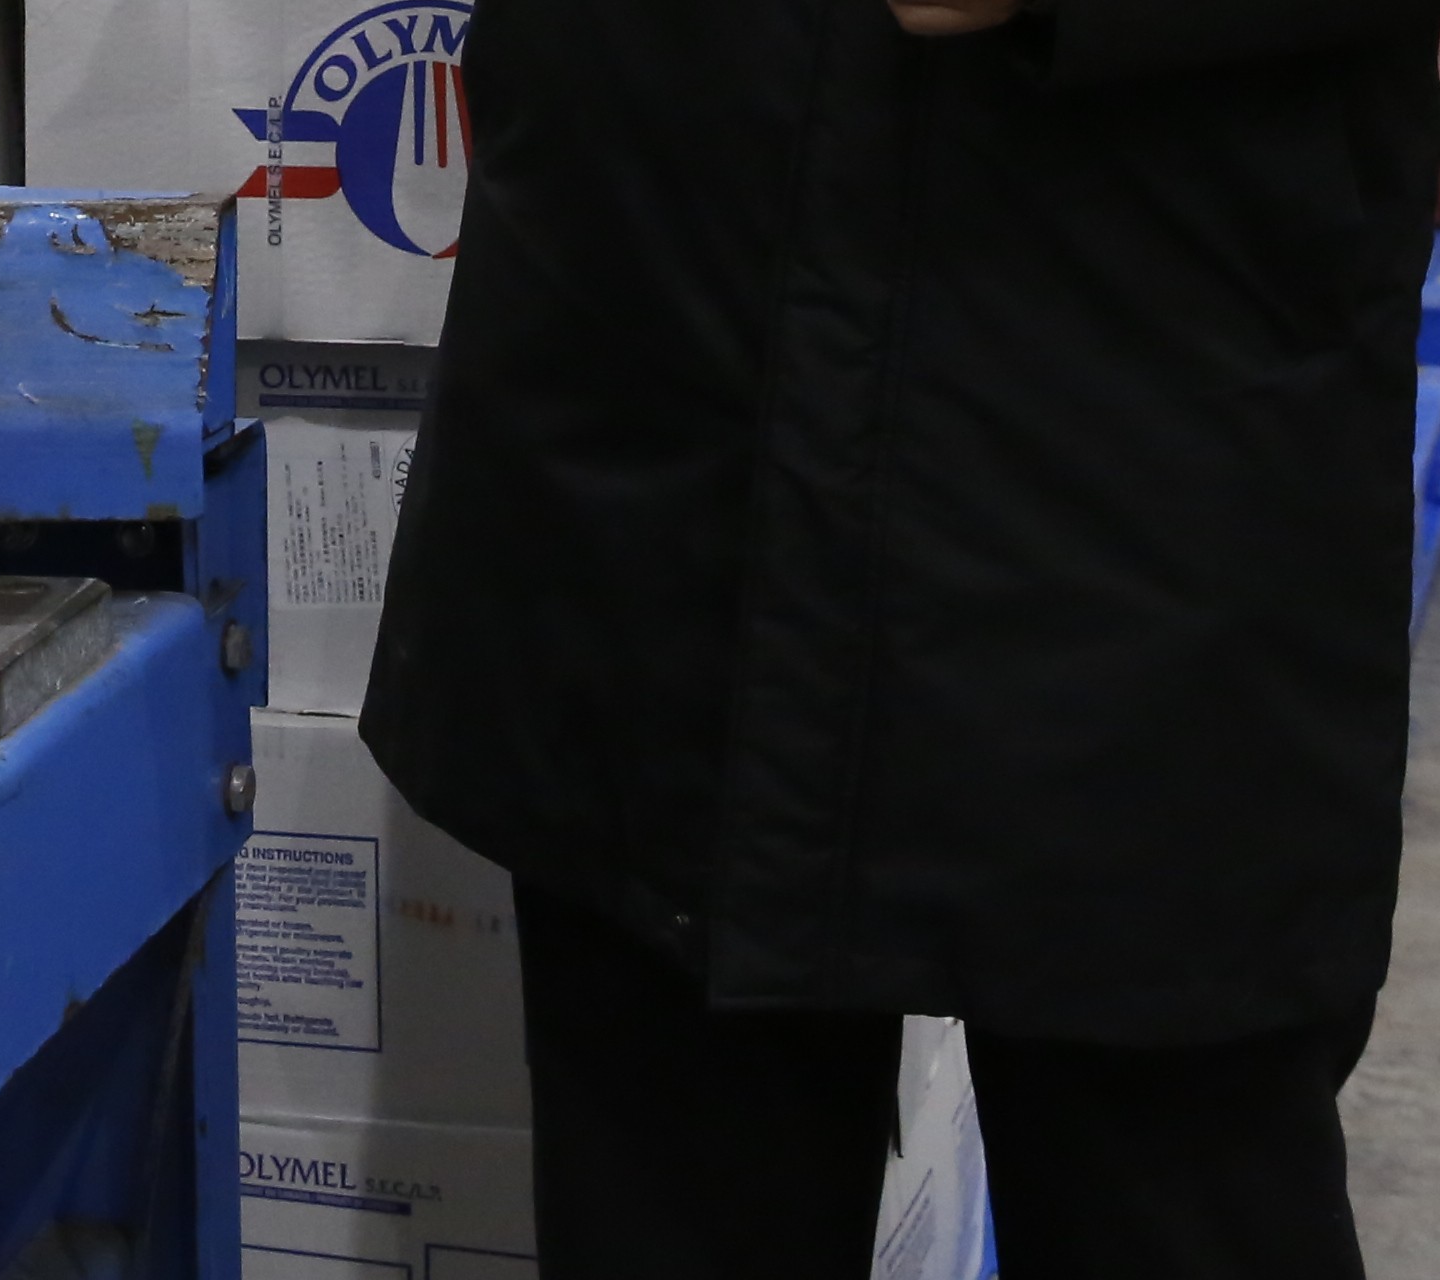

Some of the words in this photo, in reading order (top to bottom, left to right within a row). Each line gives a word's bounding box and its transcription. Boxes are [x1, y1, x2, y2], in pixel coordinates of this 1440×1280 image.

[313, 14, 471, 104] OLYM
[267, 182, 282, 246] OLYMEL
[259, 362, 387, 393] OLYMEL
[252, 846, 354, 866] INSTRUCTIONS
